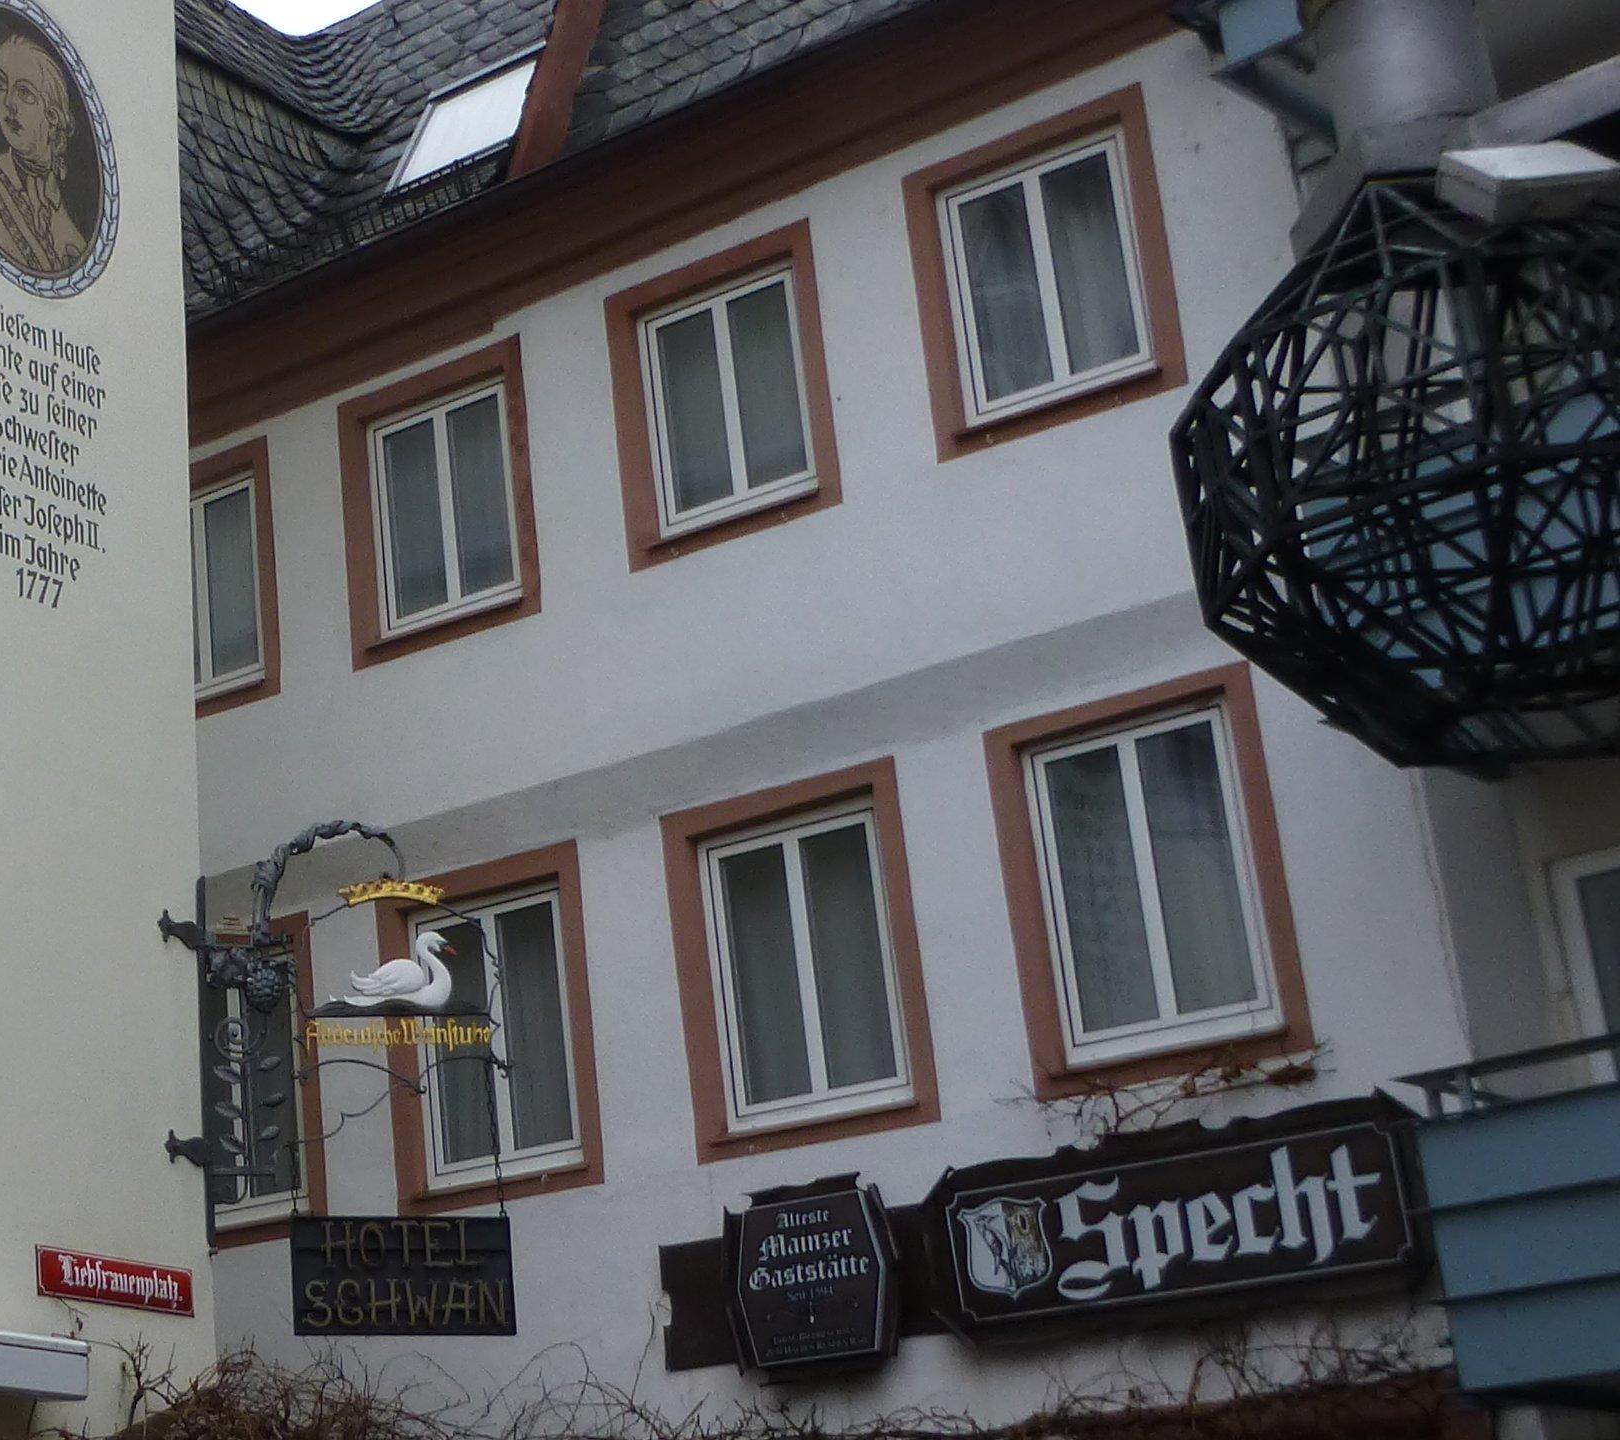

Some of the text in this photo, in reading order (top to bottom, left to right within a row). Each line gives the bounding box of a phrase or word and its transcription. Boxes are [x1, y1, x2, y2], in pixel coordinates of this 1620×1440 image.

[19, 387, 39, 415] zu
[29, 359, 59, 392] auf
[61, 370, 106, 410] einer
[19, 454, 107, 516] Antoinette
[24, 533, 81, 582] Jahre
[15, 566, 64, 609] 1777
[320, 1219, 482, 1269] HOTEL
[758, 1227, 853, 1261] Mainzer
[1053, 1144, 1381, 1301] Specht
[748, 1253, 870, 1291] Gaststätte
[302, 1277, 509, 1328] SCHWAN
